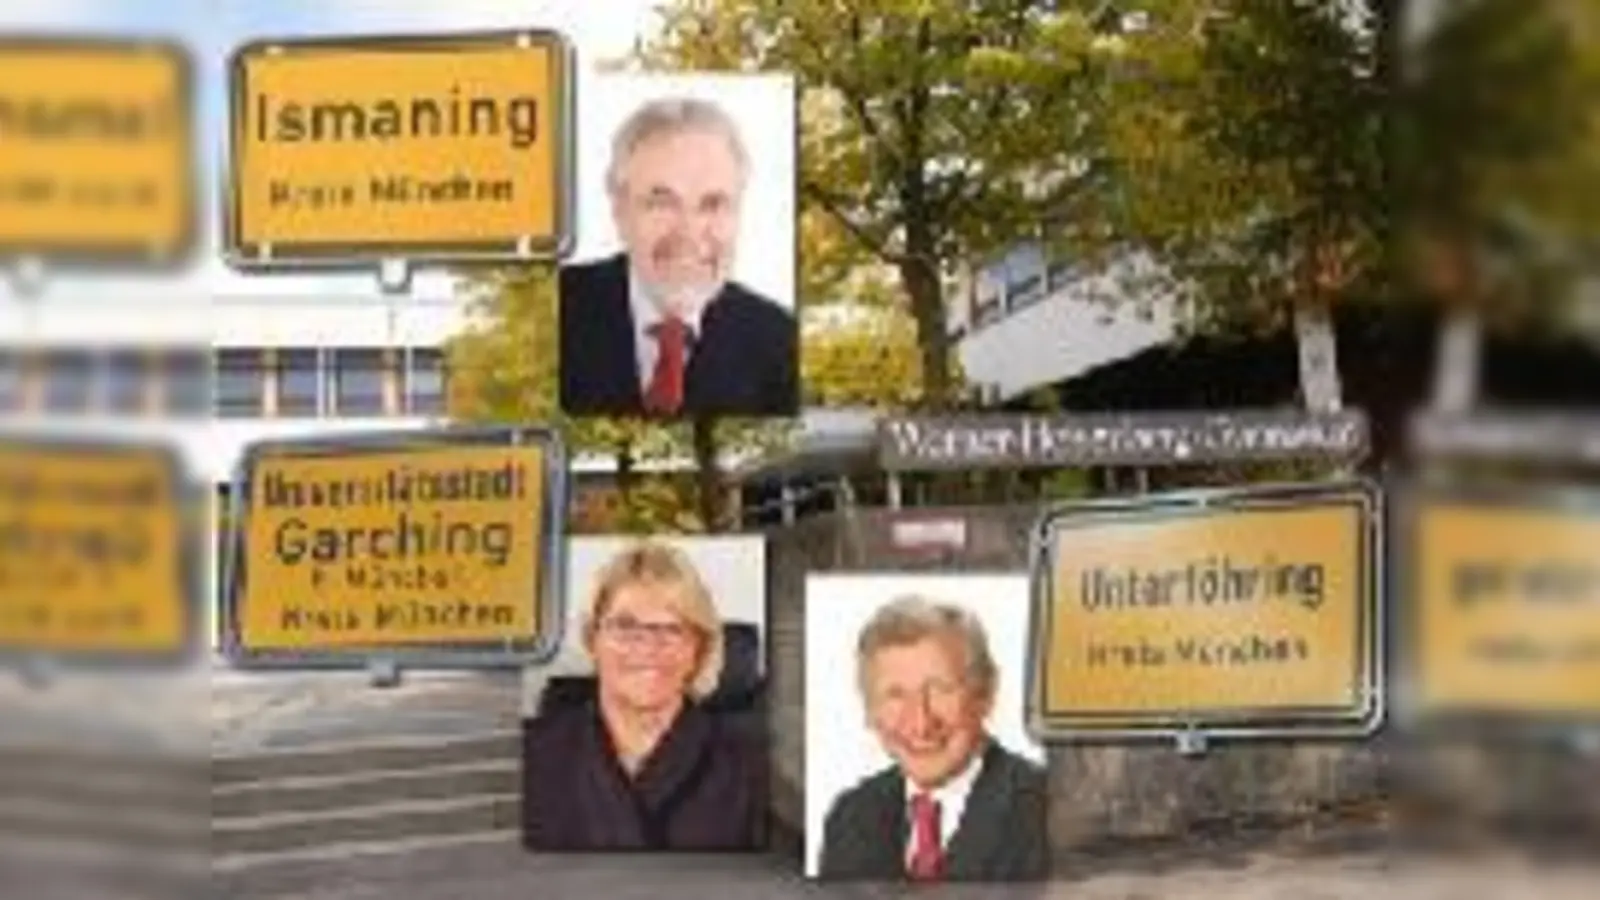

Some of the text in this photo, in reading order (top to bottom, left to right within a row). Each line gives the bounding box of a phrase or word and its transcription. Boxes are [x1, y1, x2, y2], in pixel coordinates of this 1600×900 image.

[256, 84, 538, 150] Ismaning
[275, 511, 515, 567] Garching
[1080, 555, 1325, 612] Unterföhring
